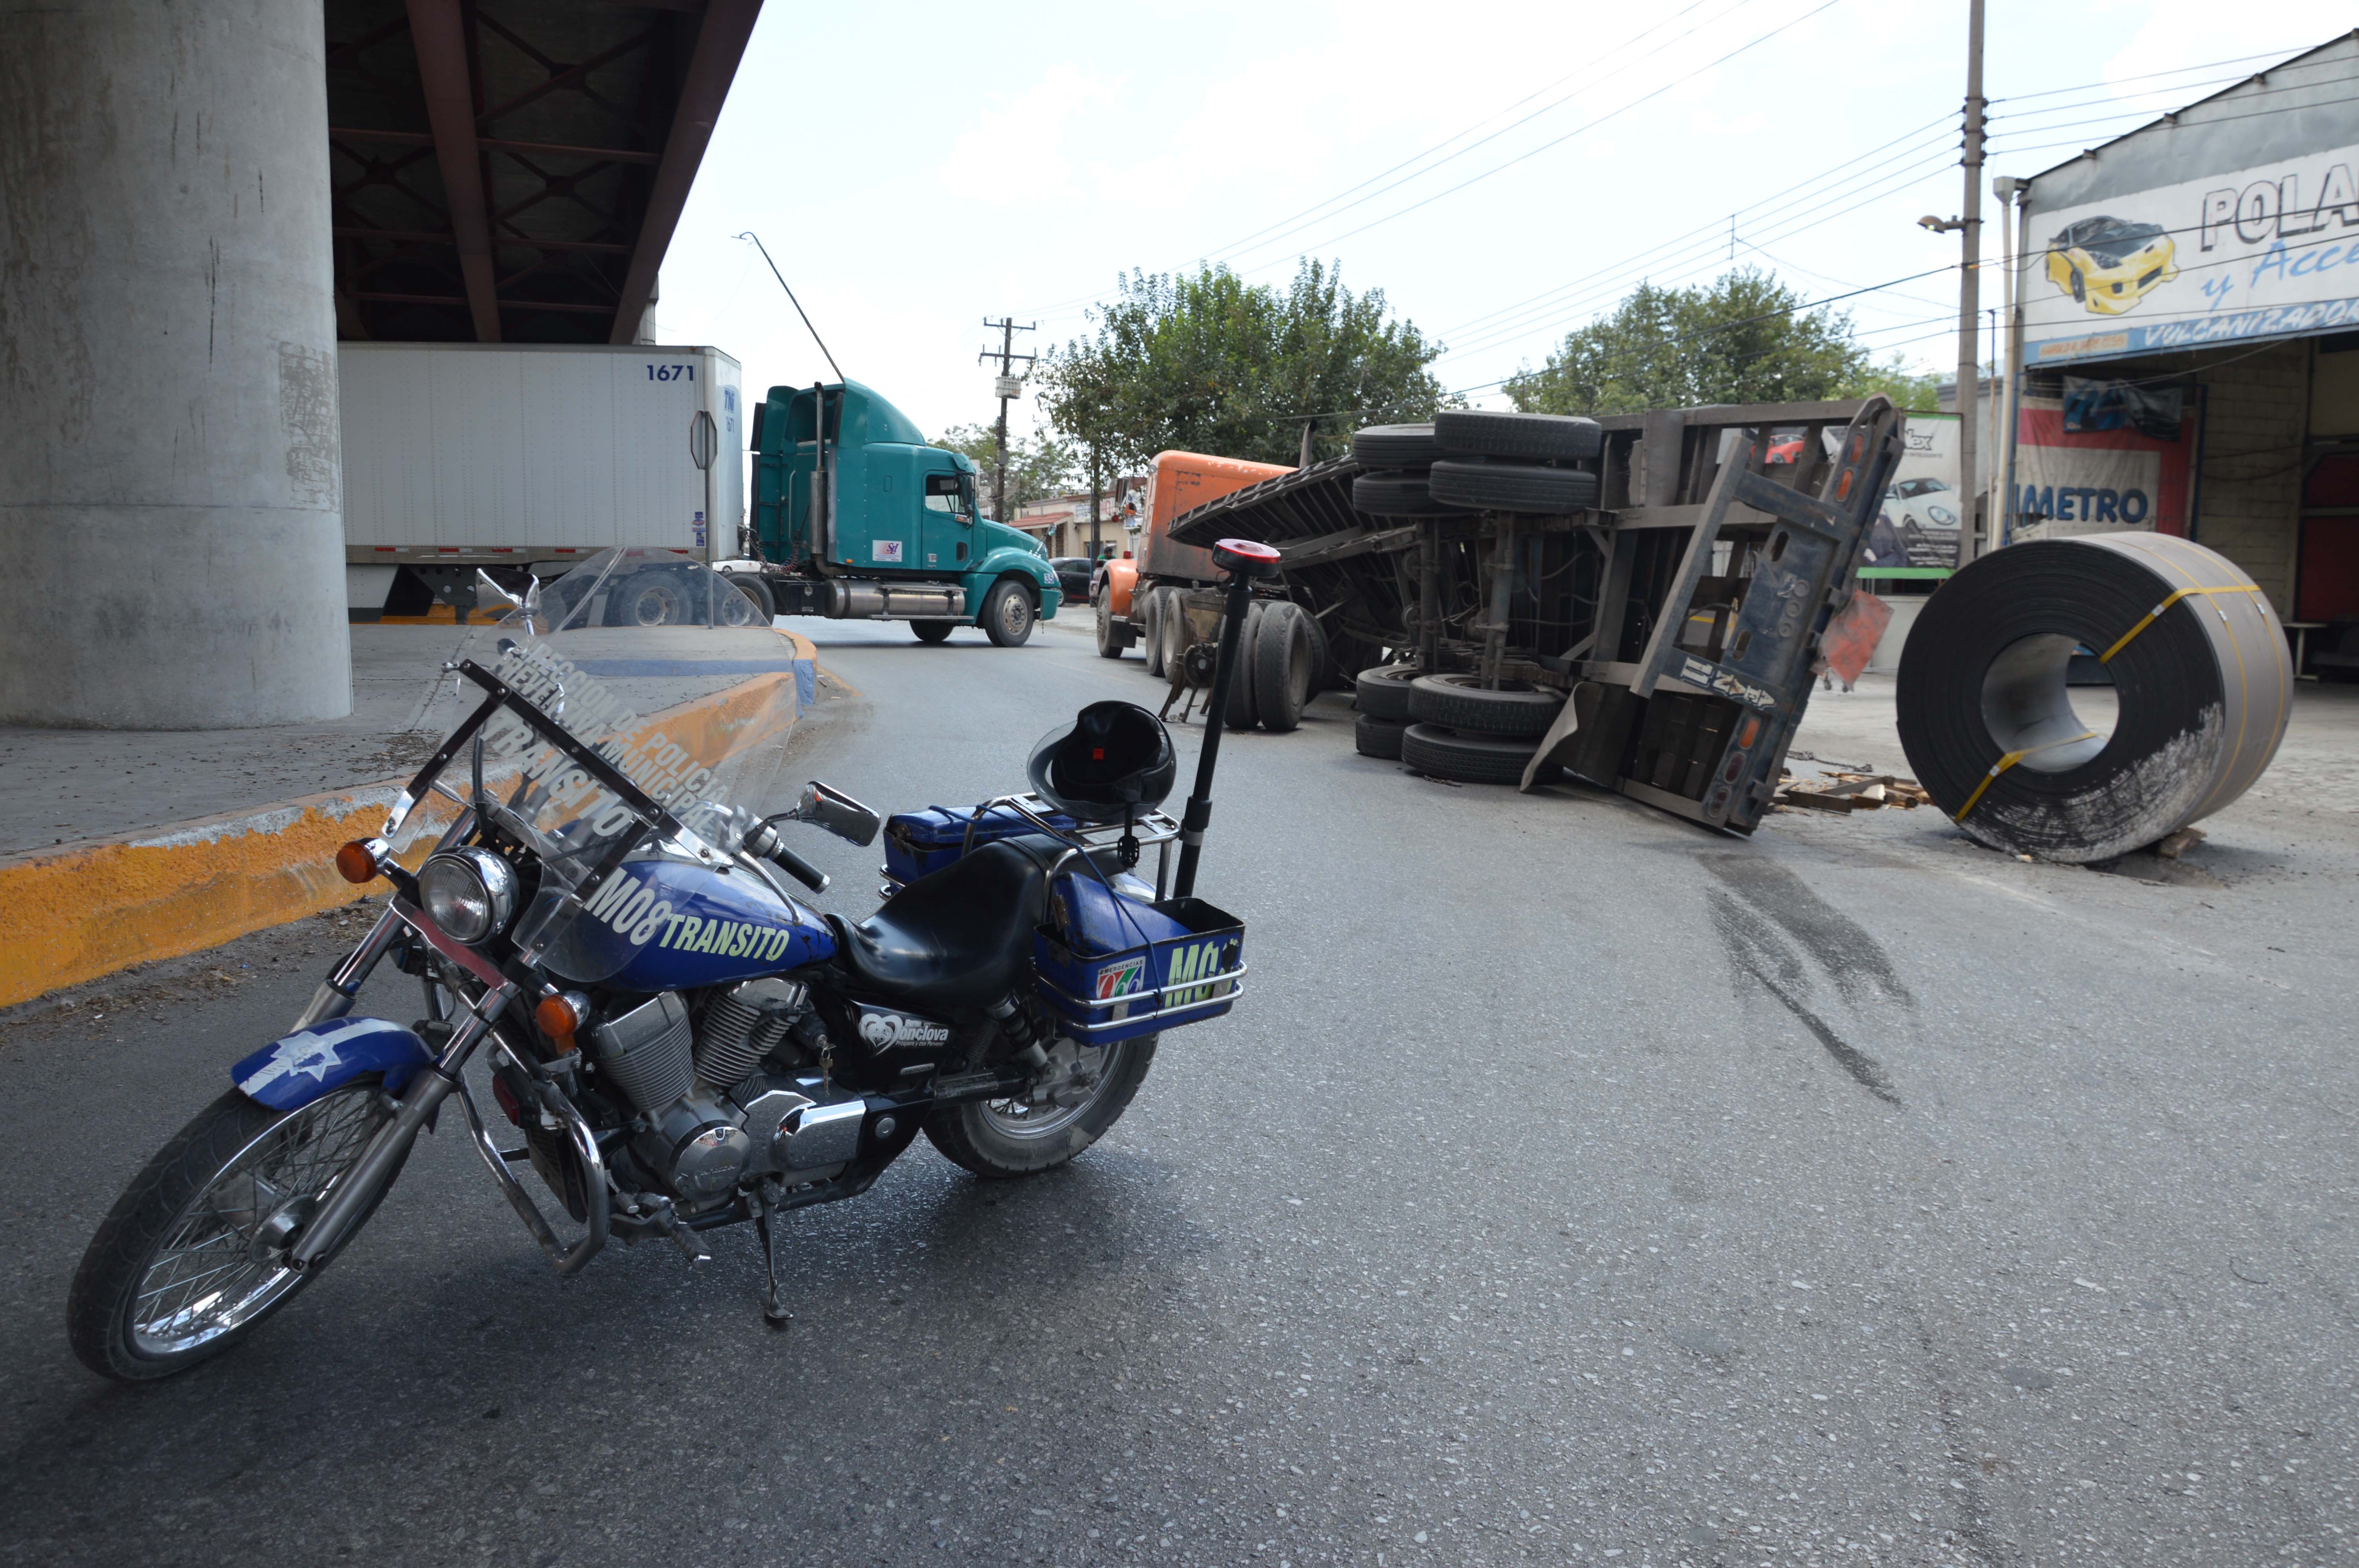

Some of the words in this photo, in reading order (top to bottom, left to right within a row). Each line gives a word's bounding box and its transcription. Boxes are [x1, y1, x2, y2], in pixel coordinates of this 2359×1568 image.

[2201, 275, 2234, 313] y
[647, 365, 693, 381] 1671
[1045, 574, 1054, 583] 35
[490, 651, 609, 747] PREVENTIVA
[598, 734, 716, 836] MUNICIPAL
[516, 635, 621, 718] DIRECCION
[609, 708, 651, 742] DE
[641, 731, 728, 809] POLICIA
[480, 707, 633, 837] TRANSITO
[584, 867, 672, 946] M08
[659, 914, 790, 962] TRANSITO
[1100, 960, 1143, 975] EMERGENCIAS
